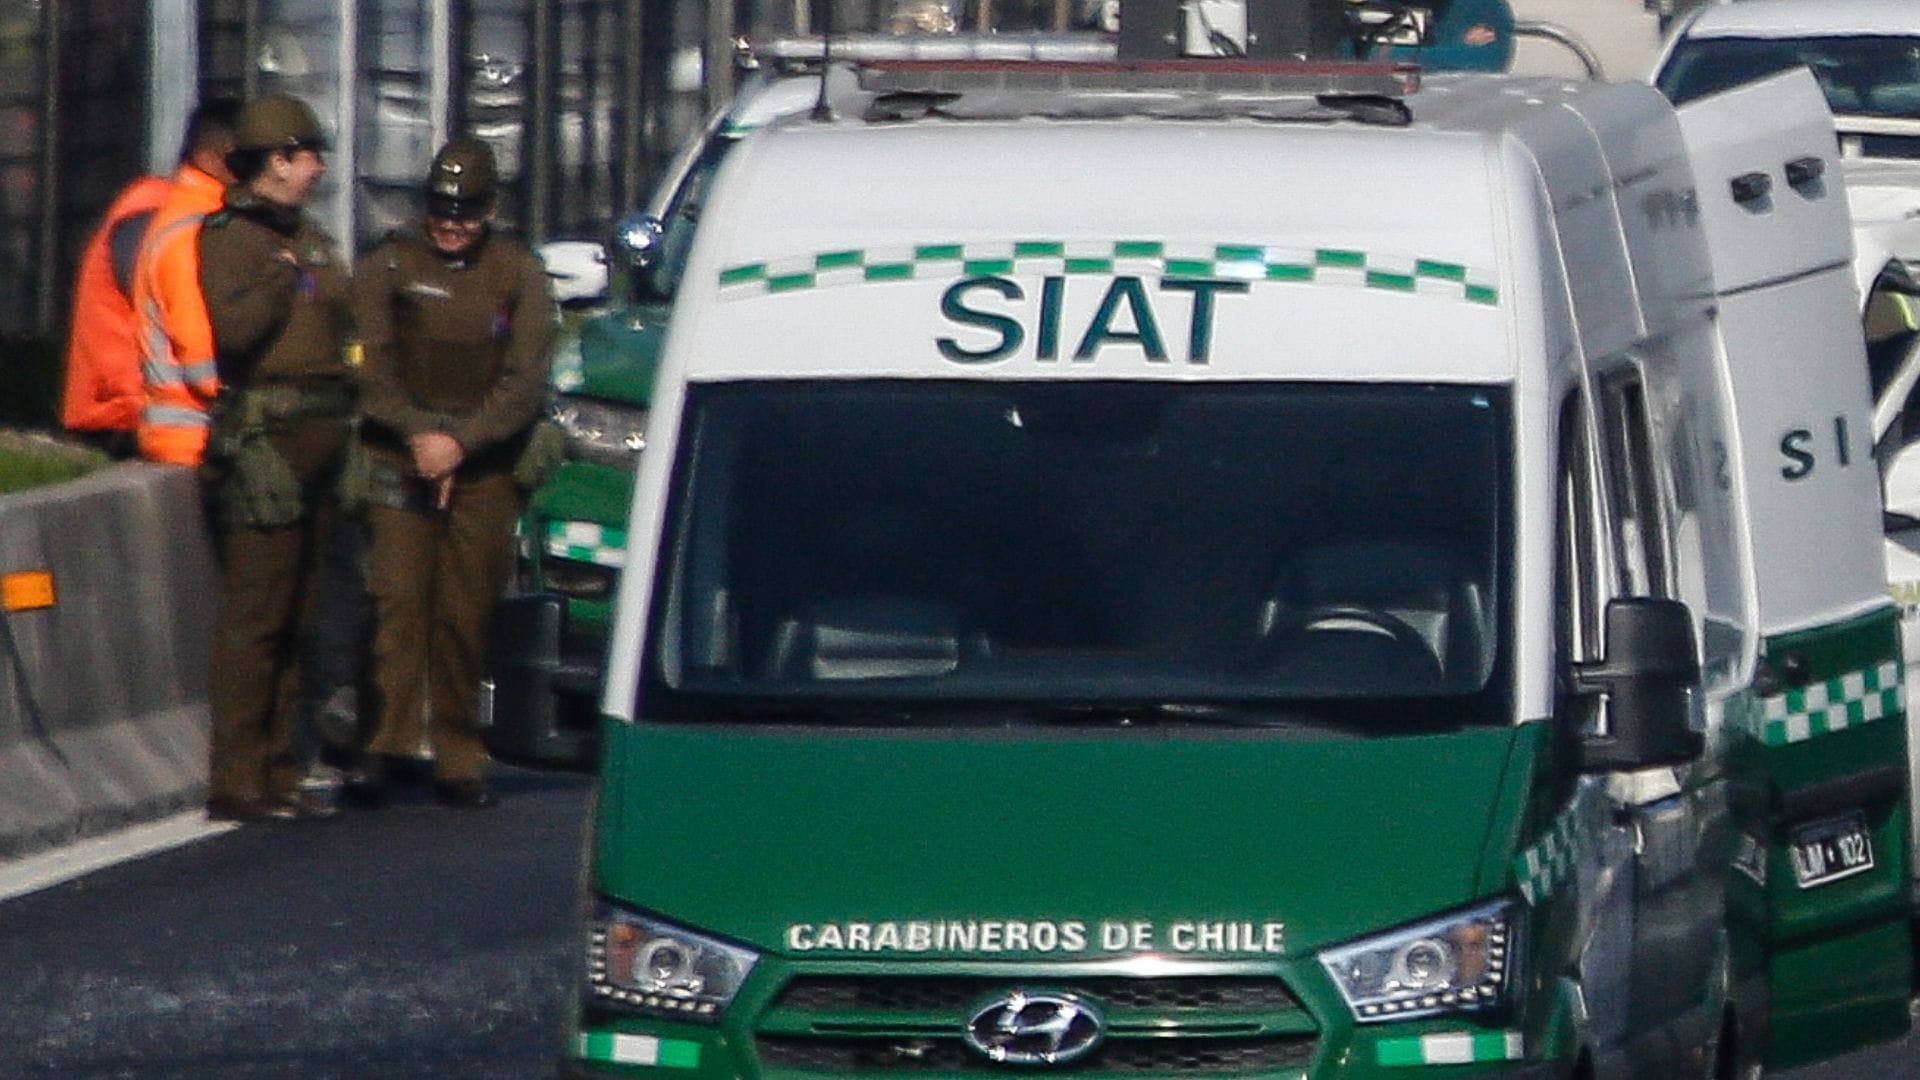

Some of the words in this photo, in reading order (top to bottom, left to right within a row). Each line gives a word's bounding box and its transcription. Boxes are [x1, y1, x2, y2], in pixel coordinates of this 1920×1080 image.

[936, 276, 1249, 364] SIAT
[788, 922, 1087, 952] CARABINEROS
[1102, 922, 1153, 951] DE
[1171, 922, 1285, 952] CHILE
